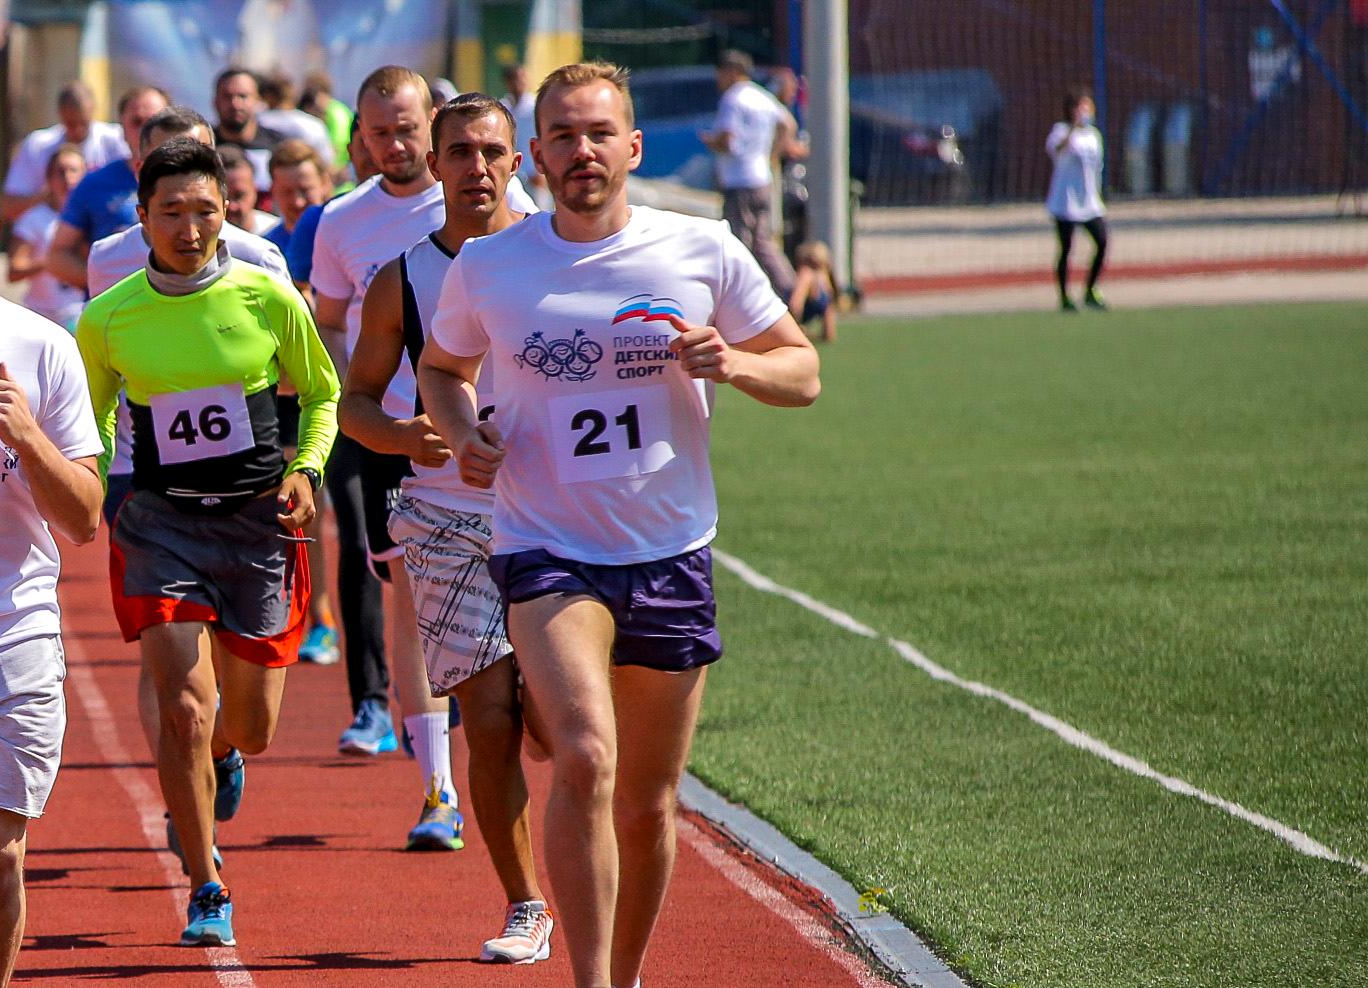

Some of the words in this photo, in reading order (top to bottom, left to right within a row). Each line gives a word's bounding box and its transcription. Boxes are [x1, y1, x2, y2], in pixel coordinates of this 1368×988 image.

[613, 334, 670, 348] ПРОЕКТ
[617, 365, 665, 379] СПОРТ
[168, 404, 232, 446] 46
[570, 404, 643, 458] 21
